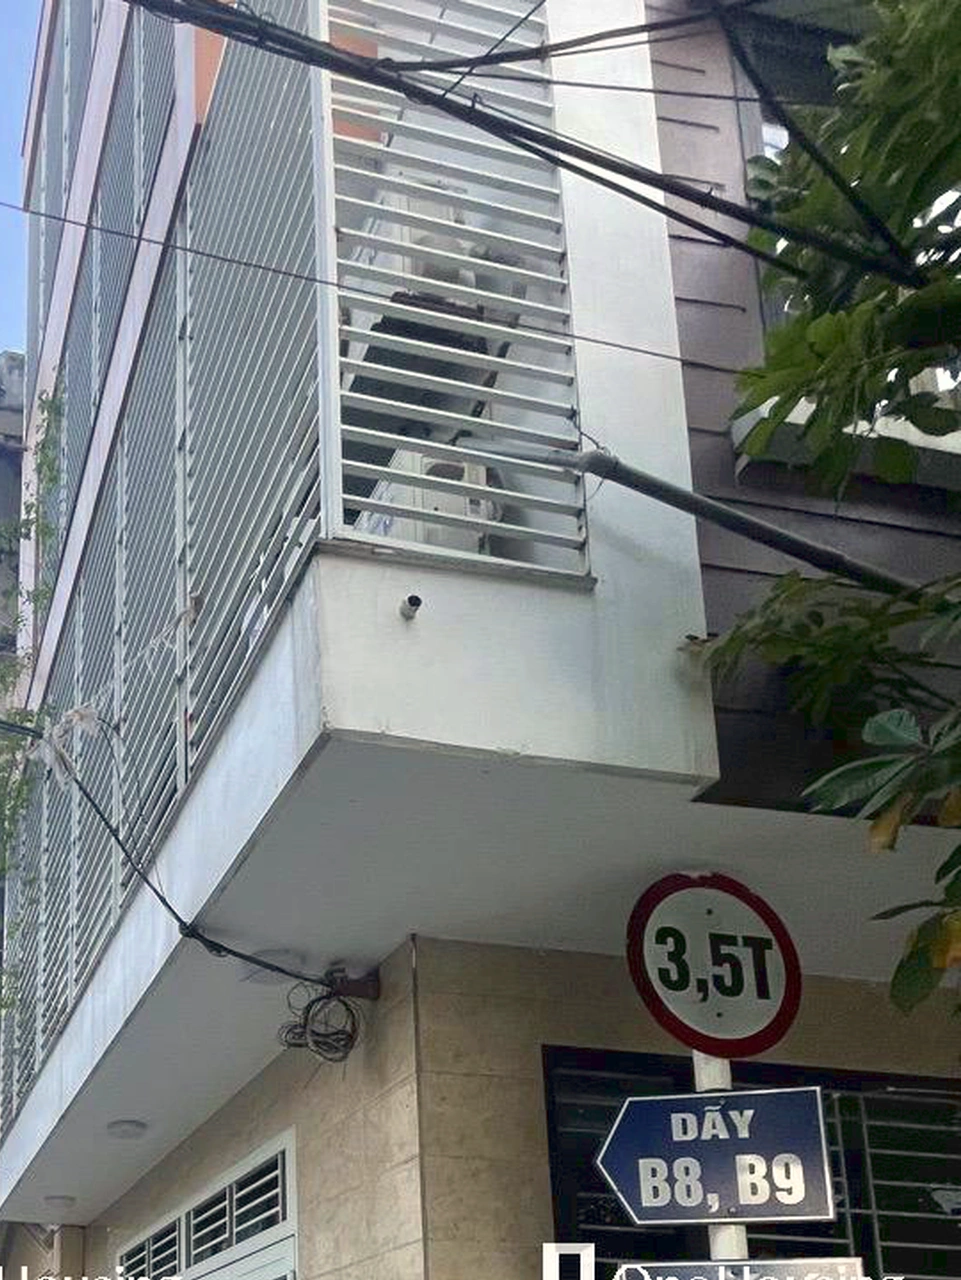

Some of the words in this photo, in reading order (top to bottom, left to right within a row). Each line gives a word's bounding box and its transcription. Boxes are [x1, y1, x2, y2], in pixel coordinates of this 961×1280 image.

[655, 926, 773, 1002] 3,5T
[670, 1104, 755, 1142] DÃY
[638, 1157, 720, 1213] B8,
[735, 1153, 806, 1206] B9
